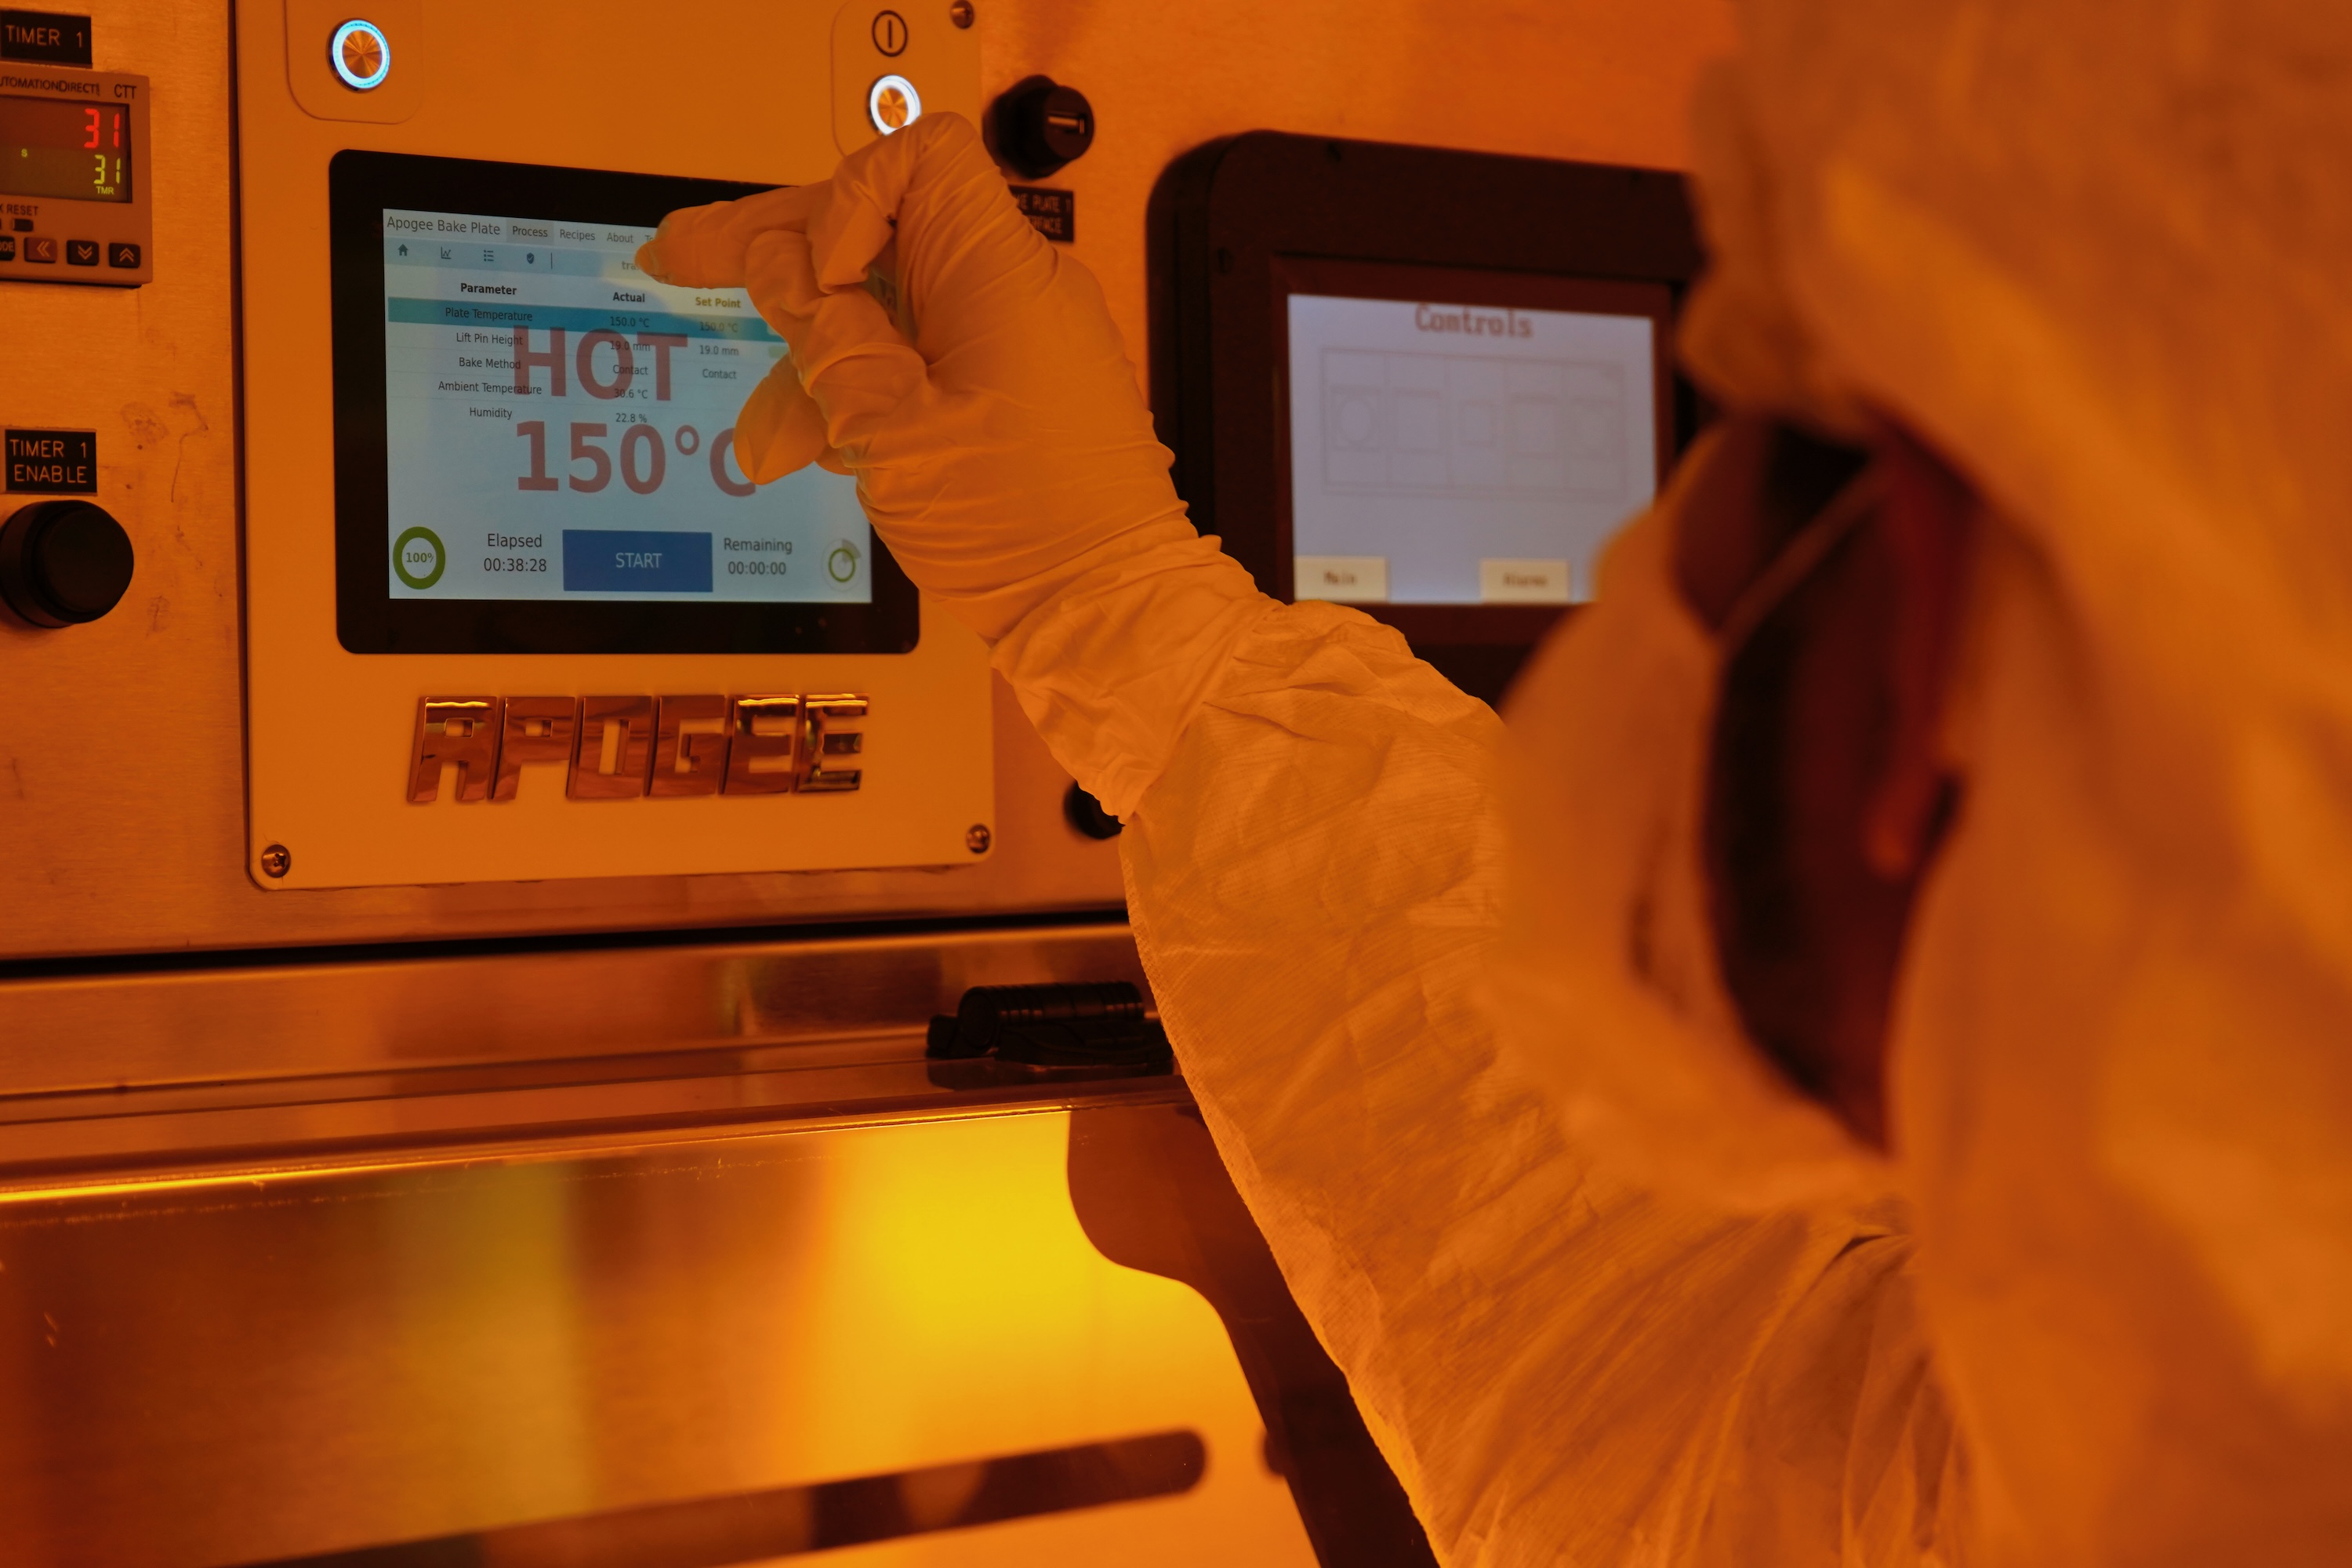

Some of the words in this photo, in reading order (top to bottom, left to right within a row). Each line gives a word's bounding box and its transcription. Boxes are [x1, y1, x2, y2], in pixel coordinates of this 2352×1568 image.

[5, 24, 61, 46] TIMER
[76, 31, 83, 49] 1
[114, 84, 137, 100] CTT
[84, 108, 121, 149] 31
[93, 154, 122, 184] 31
[96, 186, 114, 195] TMR
[6, 204, 38, 216] RESET
[387, 216, 433, 231] Apogee
[437, 220, 467, 234] Bake
[470, 222, 500, 235] Plate
[512, 225, 548, 238] Process
[560, 229, 596, 241] Recipes
[607, 232, 633, 244] About
[460, 283, 517, 296] Parameter
[613, 292, 645, 303] Actual
[695, 296, 712, 307] Set
[715, 297, 742, 309] Point
[445, 307, 470, 319] Plate
[472, 308, 533, 322] Temperature
[610, 316, 637, 327] 150.0
[699, 321, 724, 332] 150.0
[1414, 301, 1534, 339] Controls
[456, 332, 471, 343] Lift
[474, 333, 488, 344] Pin
[492, 334, 524, 347] Height
[611, 340, 630, 351] 19.0
[633, 342, 651, 352] mm
[699, 345, 719, 356] 19.0
[722, 347, 739, 356] mm
[459, 357, 482, 368] Bake
[485, 358, 521, 370] Method
[612, 364, 648, 376] Contact
[702, 368, 737, 379] Contact
[514, 325, 688, 401] HOT
[438, 381, 480, 393] Ambient
[481, 382, 543, 395] Temperature
[614, 388, 634, 399] 30.6
[470, 407, 513, 420] Humidity
[615, 412, 636, 423] 22.8
[638, 413, 648, 423] %
[9, 439, 65, 458] TIMER
[80, 441, 87, 459] 1
[516, 421, 757, 497] 150°C
[14, 464, 87, 484] ENABLE
[487, 533, 543, 550] Elapsed
[724, 537, 793, 554] Remaining
[483, 557, 547, 572] 00:38:28
[615, 552, 662, 568] START
[728, 561, 787, 575] 00:00:00
[407, 692, 869, 804] APOGEE
